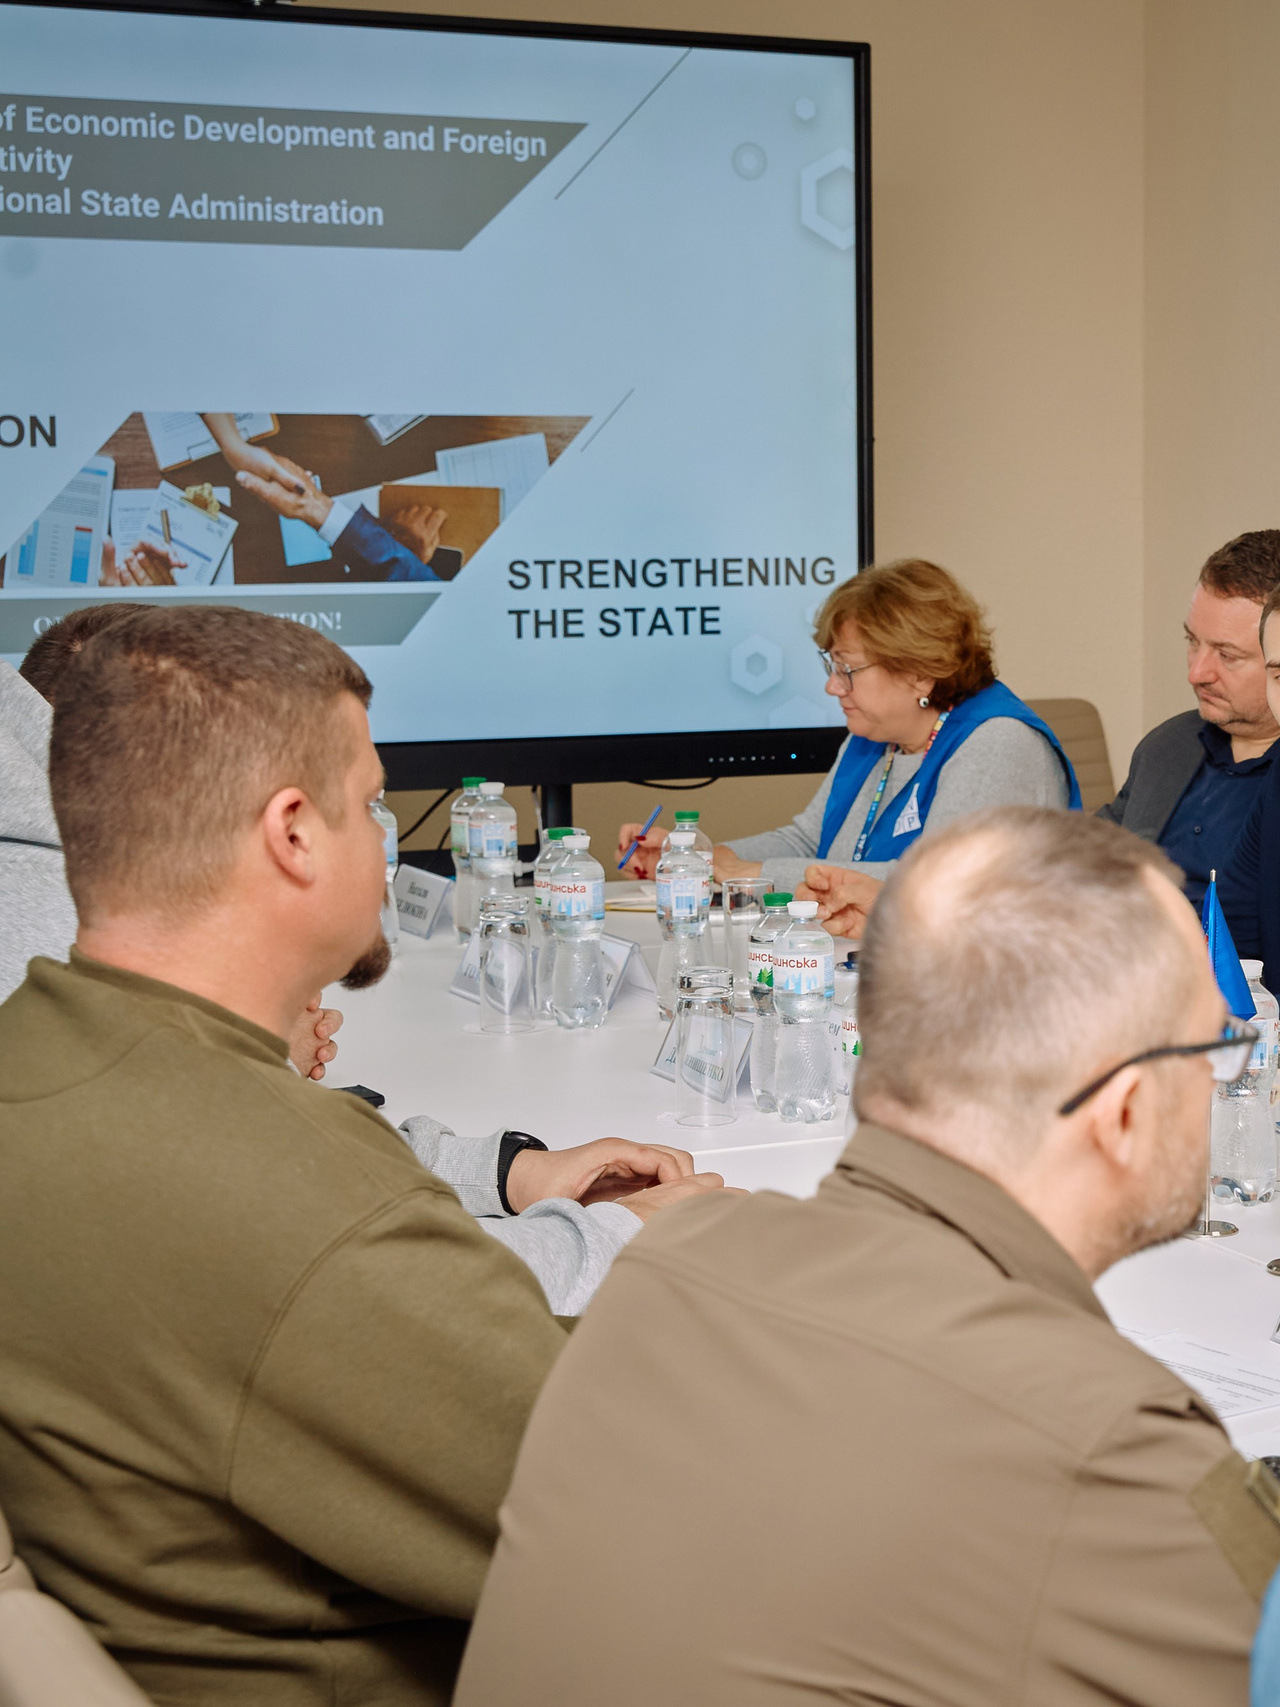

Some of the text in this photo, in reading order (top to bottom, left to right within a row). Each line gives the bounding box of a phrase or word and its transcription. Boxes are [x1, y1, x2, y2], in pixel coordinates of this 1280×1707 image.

[26, 106, 175, 140] Economic
[184, 114, 376, 151] Development
[383, 126, 435, 151] and
[444, 128, 547, 163] Foreign
[81, 188, 160, 218] State
[169, 193, 385, 226] Administration
[508, 557, 836, 590] STRENGTHENING
[508, 606, 721, 639] THE STATE
